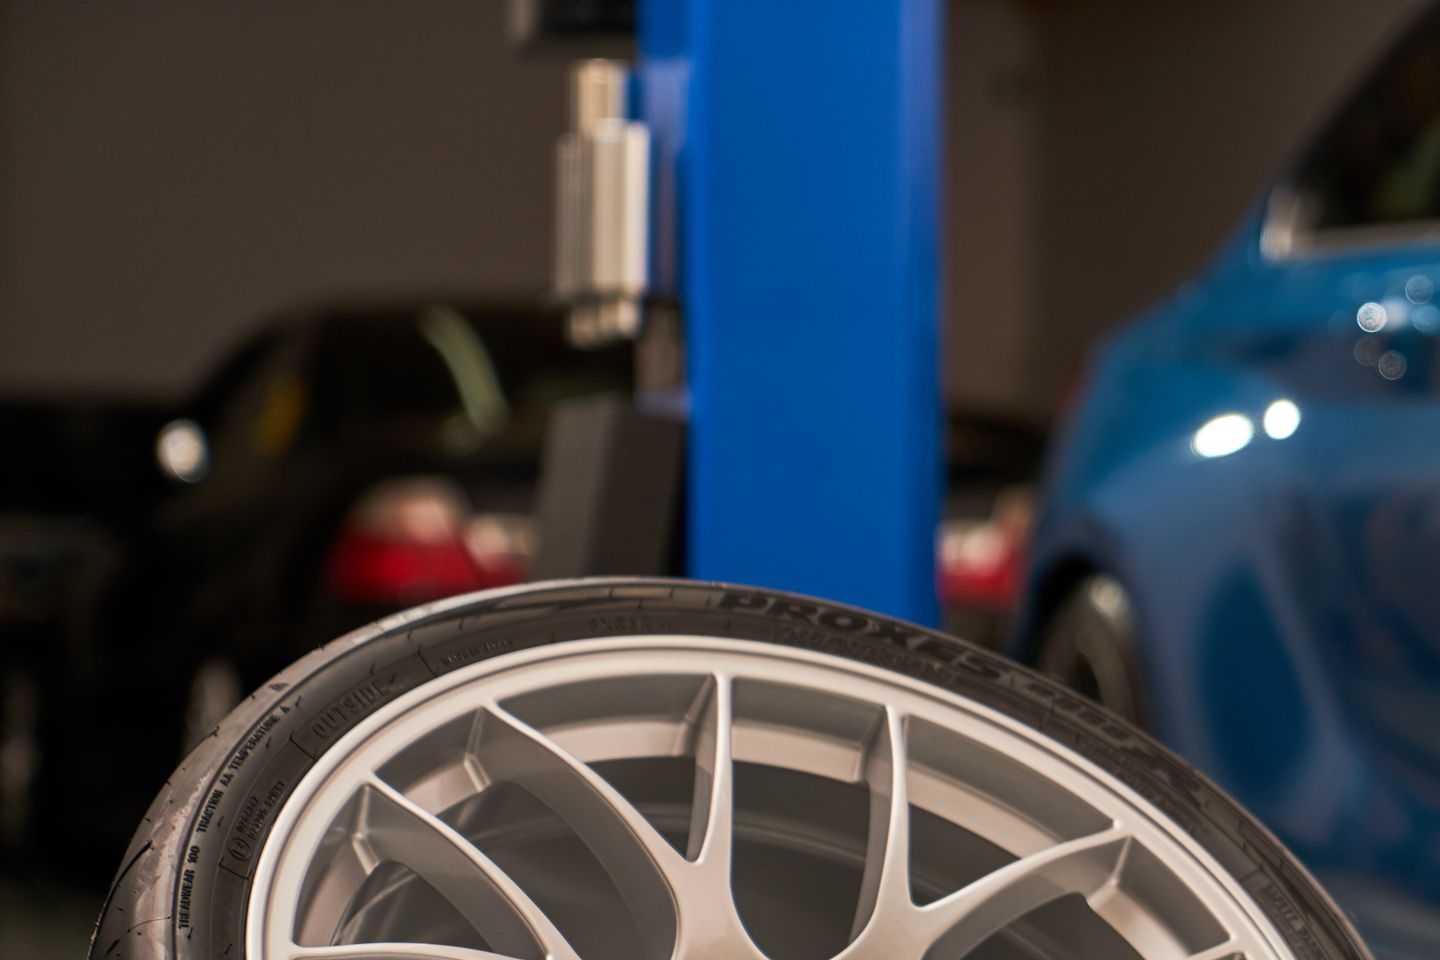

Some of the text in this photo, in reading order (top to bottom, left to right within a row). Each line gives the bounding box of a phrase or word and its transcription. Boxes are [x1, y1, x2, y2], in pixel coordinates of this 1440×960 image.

[720, 592, 1002, 679] PROXES
[311, 677, 389, 738] OUTSIDE
[178, 868, 196, 929] TREADWEAR
[187, 845, 200, 865] 100
[197, 789, 223, 834] TRACTION
[219, 772, 235, 787] AA
[229, 714, 281, 771] TEMPERATURE
